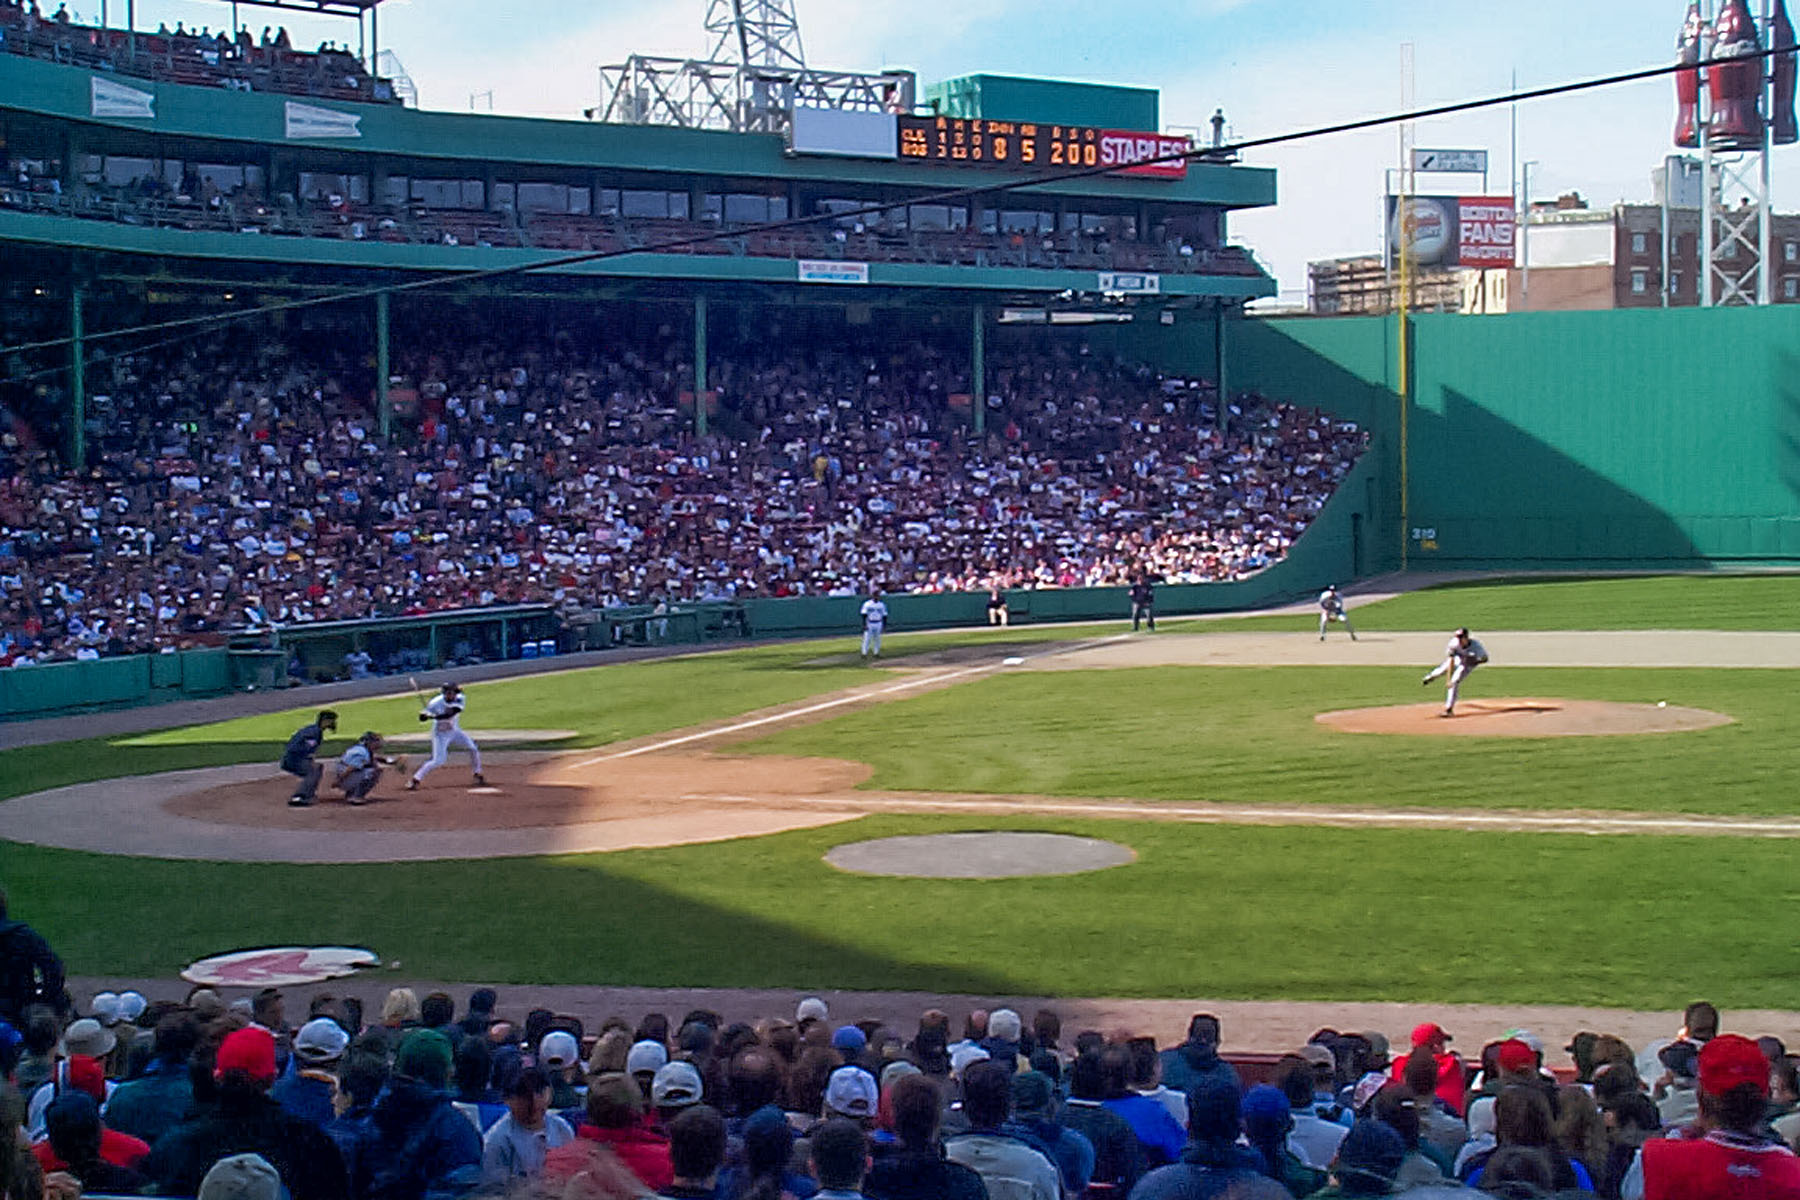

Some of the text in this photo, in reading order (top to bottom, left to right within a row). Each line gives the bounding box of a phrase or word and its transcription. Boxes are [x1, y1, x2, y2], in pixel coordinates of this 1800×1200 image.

[994, 137, 1007, 161] 8
[1021, 138, 1035, 162] 5
[1101, 136, 1186, 169] STAPLES
[1460, 222, 1513, 244] FANS
